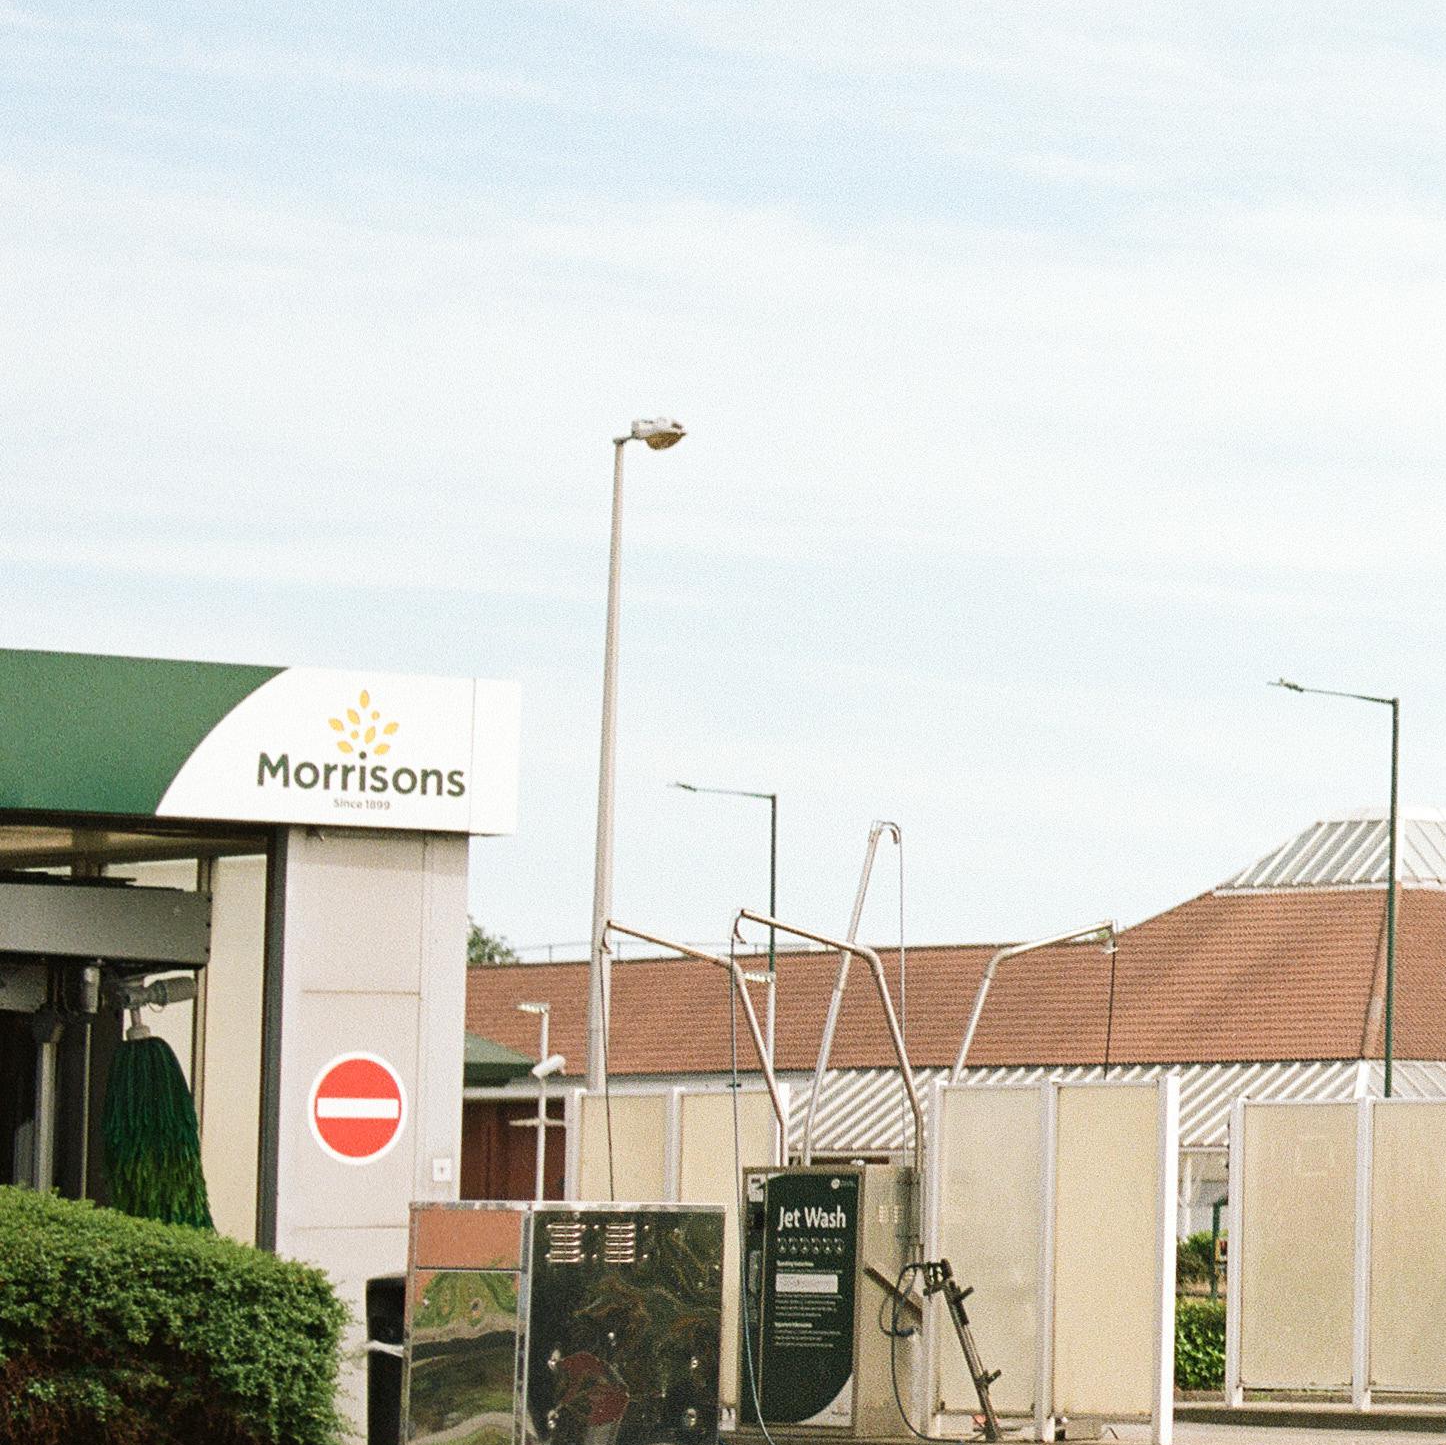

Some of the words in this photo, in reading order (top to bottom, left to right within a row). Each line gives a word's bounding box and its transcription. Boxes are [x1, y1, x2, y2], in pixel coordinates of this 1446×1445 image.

[256, 751, 466, 798] Morrisons
[333, 798, 362, 809] Since
[365, 800, 391, 811] 1899
[777, 1206, 801, 1231] Jet
[803, 1205, 847, 1228] Wash
